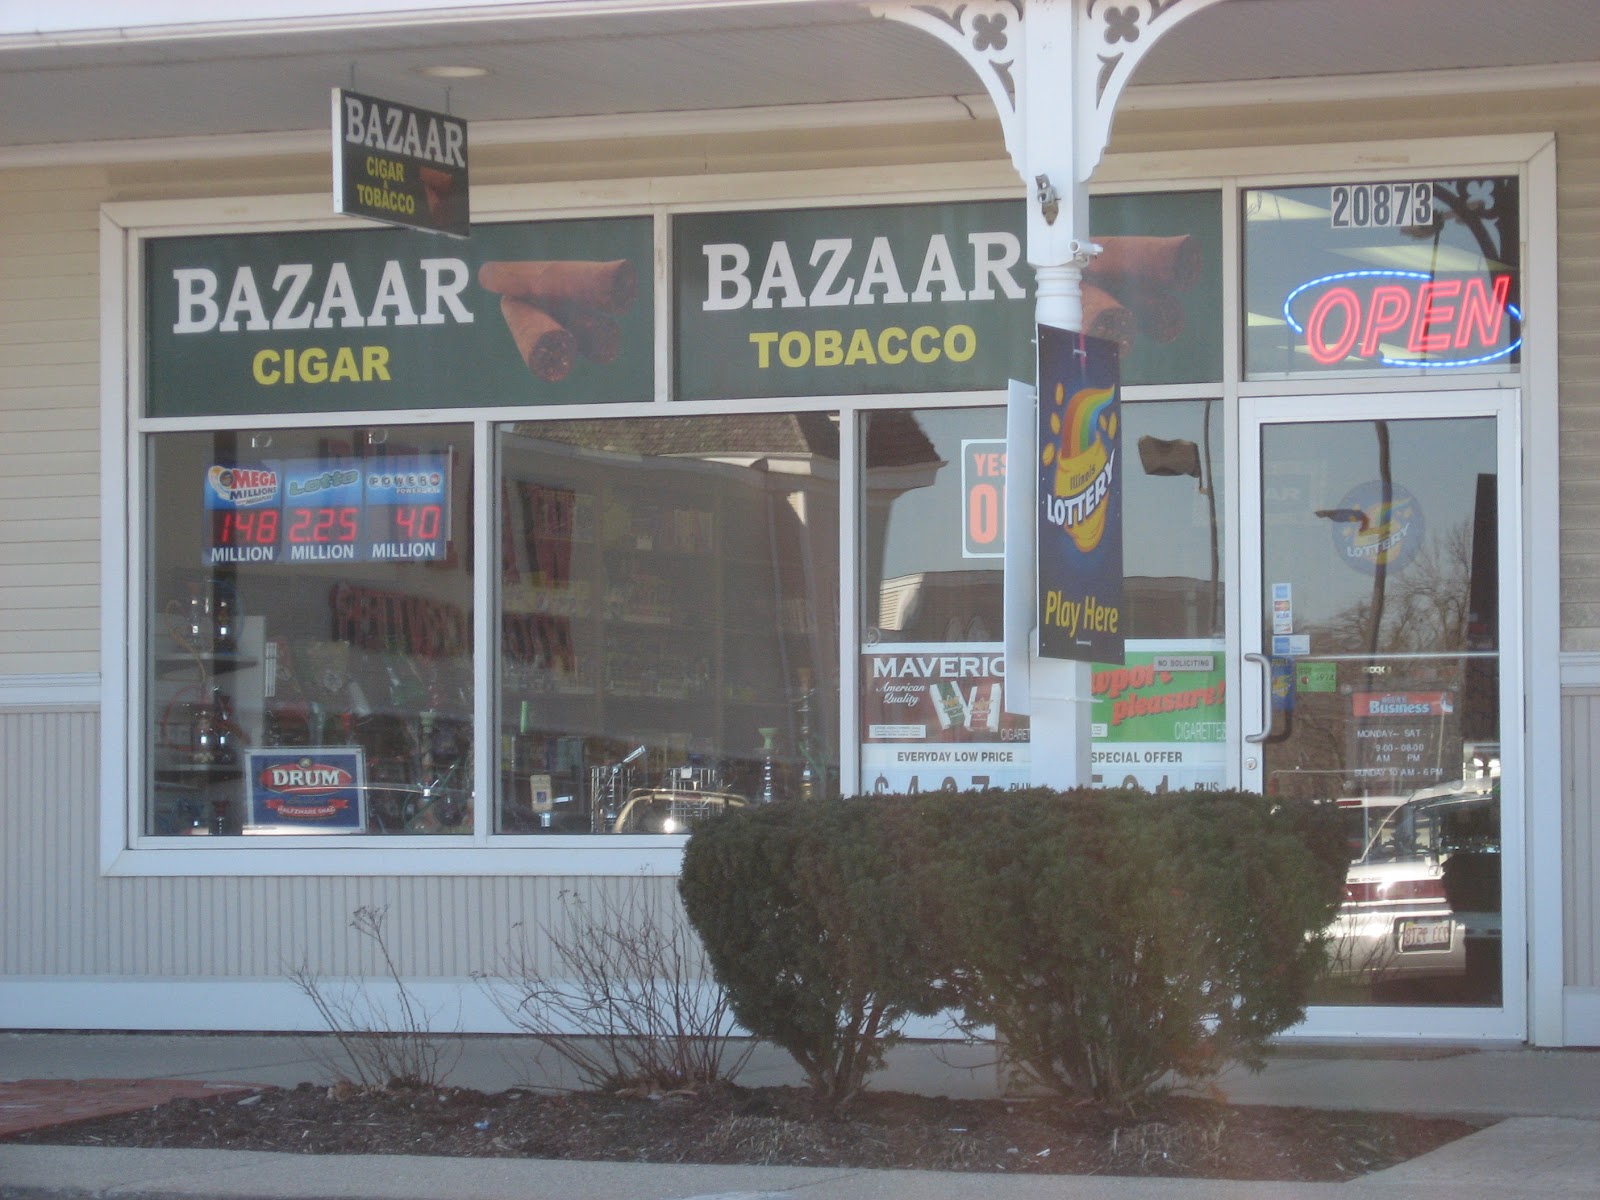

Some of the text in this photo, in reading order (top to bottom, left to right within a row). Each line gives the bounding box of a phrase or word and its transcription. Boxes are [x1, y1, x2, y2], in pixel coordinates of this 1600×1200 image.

[345, 96, 466, 168] BAZAAR
[366, 156, 404, 182] CIGAR
[356, 184, 415, 215] TOBACCO
[1332, 186, 1432, 227] 20873
[702, 231, 1027, 312] BAZAAR
[172, 257, 475, 335] BAZAAR
[1305, 275, 1511, 365] OPEN
[749, 324, 977, 369] TOBACCO
[252, 345, 392, 386] CIGAR
[230, 469, 277, 490] MEGA
[289, 470, 359, 496] Lotto
[1047, 448, 1115, 526] LOTTERY
[229, 486, 277, 501] MILLIONS
[220, 510, 278, 544] 148
[396, 506, 441, 539] 40
[211, 547, 274, 562] MILLION
[291, 545, 354, 560] MILLION
[372, 543, 436, 558] MILLION
[1045, 590, 1119, 638] Play Here
[873, 656, 1005, 679] MAVERIC
[1158, 659, 1167, 667] NO
[876, 682, 925, 692] American
[883, 692, 919, 707] Quality
[1369, 700, 1430, 714] Business
[897, 752, 1013, 762] EVERYDAY LOW PRICE
[1091, 752, 1182, 763] SPECIAL OFFER
[1407, 754, 1420, 762] PM
[272, 769, 340, 786] DRUM
